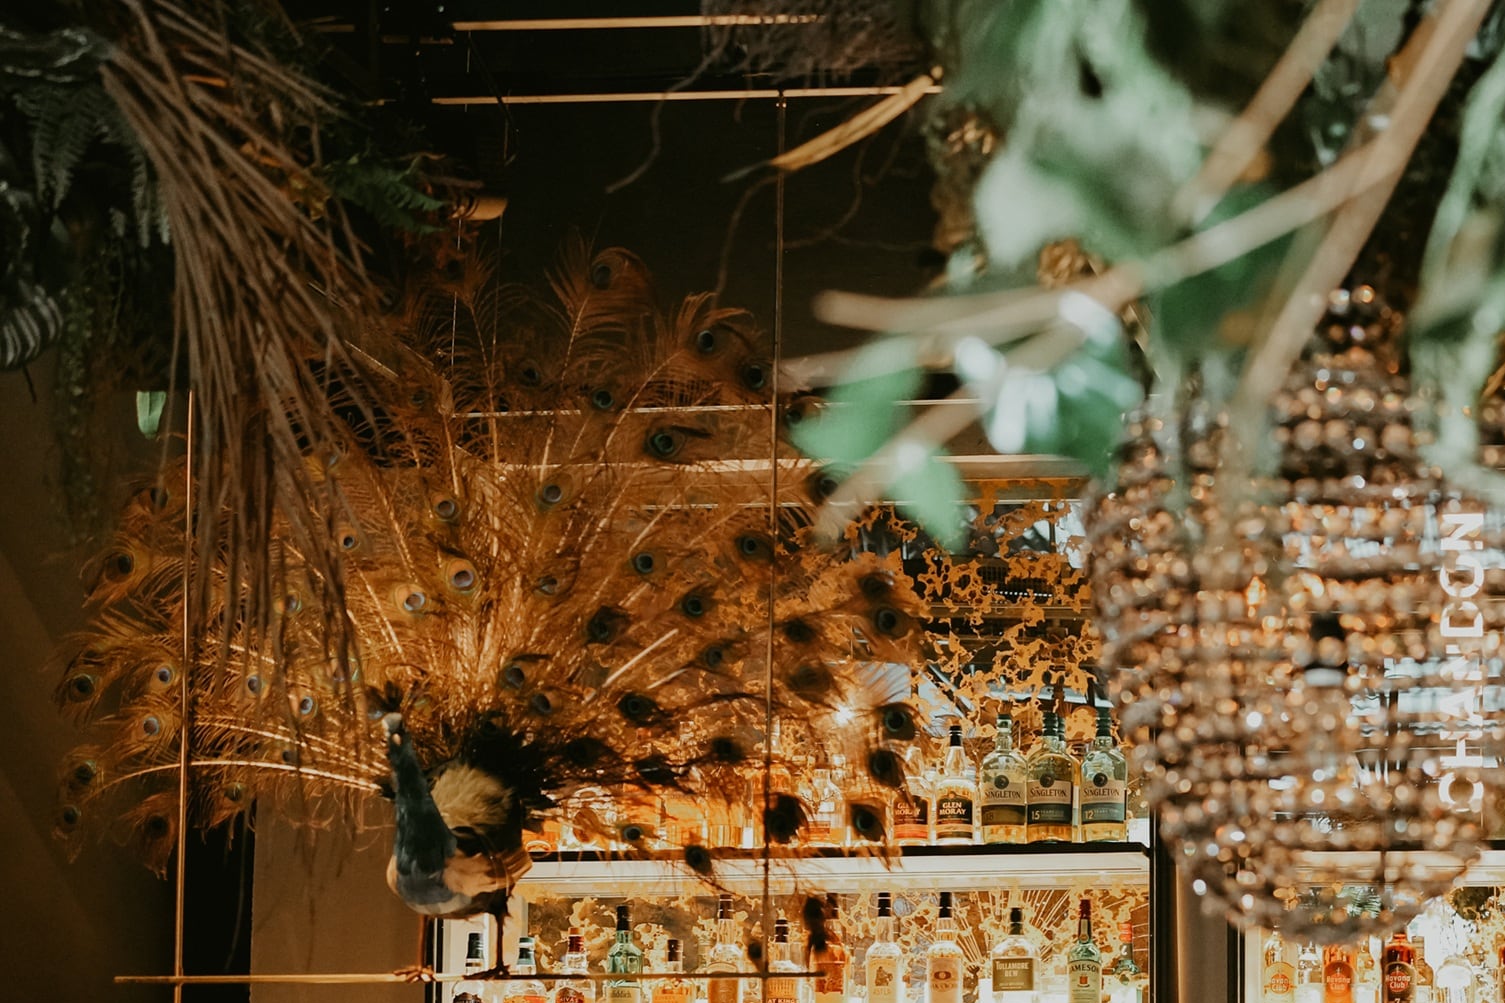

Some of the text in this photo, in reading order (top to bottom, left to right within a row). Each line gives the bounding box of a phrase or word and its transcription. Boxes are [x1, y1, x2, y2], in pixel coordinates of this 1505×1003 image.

[1029, 788, 1067, 798] SINGLETON
[1083, 788, 1120, 797] SINGLETON
[942, 801, 962, 809] GLEN
[1031, 811, 1040, 820] 15
[1085, 811, 1095, 820] 12
[996, 961, 1029, 970] TULLAMORE
